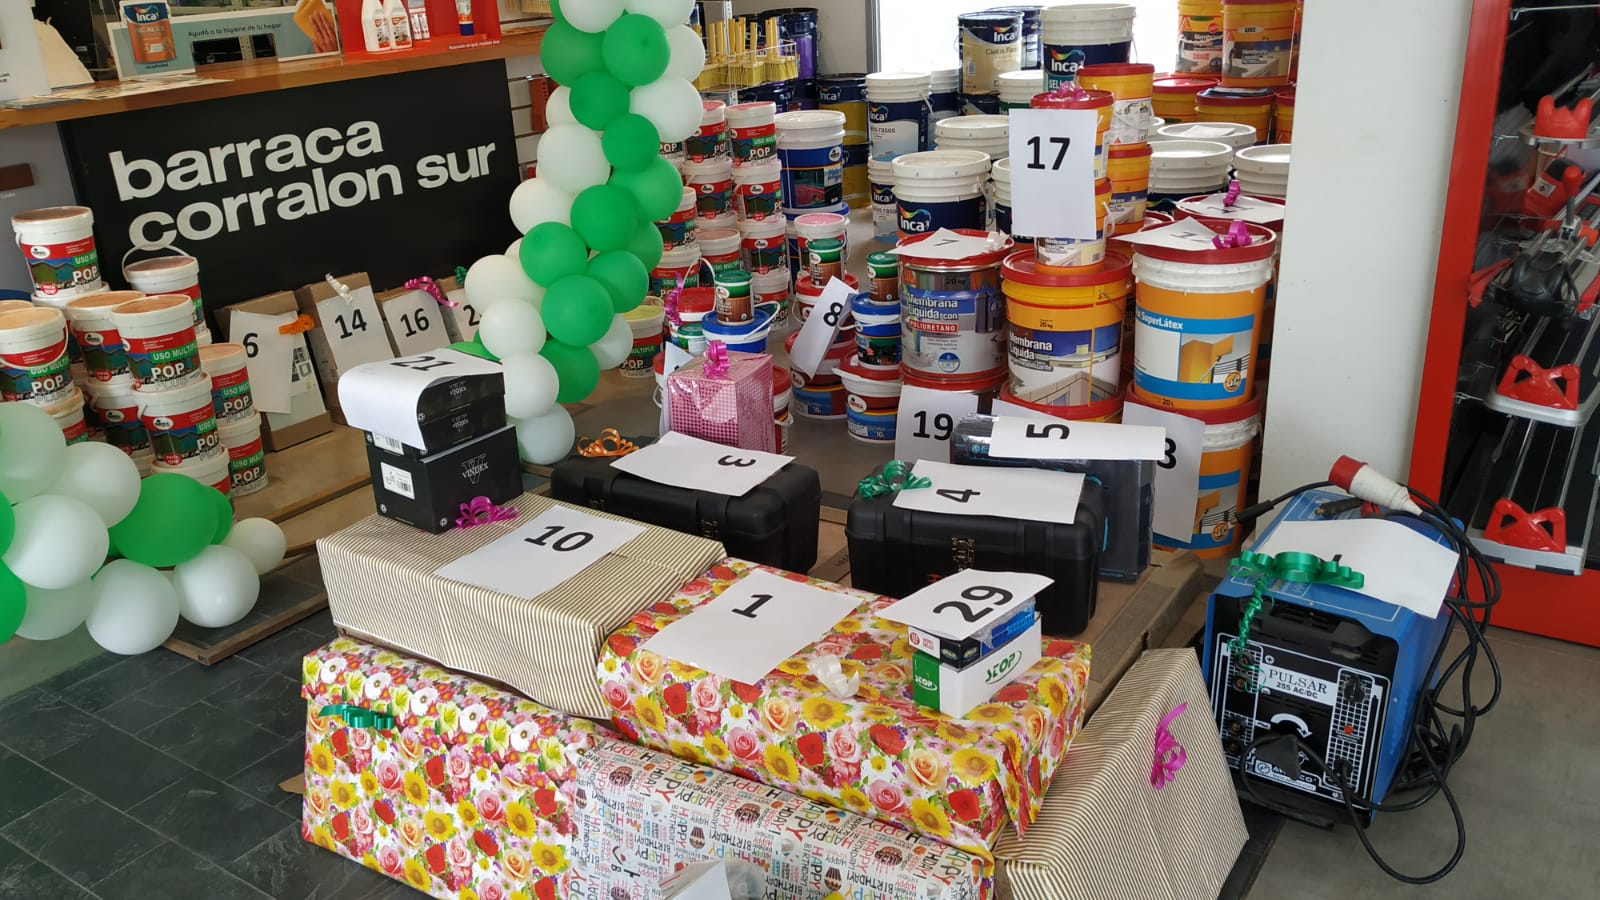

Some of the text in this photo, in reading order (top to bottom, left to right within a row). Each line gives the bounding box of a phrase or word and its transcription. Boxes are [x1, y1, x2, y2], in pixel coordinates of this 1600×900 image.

[136, 12, 157, 22] Inca
[993, 32, 1016, 42] Inca
[1051, 59, 1078, 73] Inca
[108, 119, 384, 201] barraca
[750, 147, 770, 158] POP
[1027, 136, 1071, 171] 17
[128, 141, 497, 250] corralon sur
[900, 218, 925, 232] Inca
[73, 266, 97, 284] POP
[908, 292, 958, 309] Membrana
[334, 308, 367, 339] 14
[400, 308, 430, 338] 16
[822, 302, 844, 327] 8
[943, 312, 958, 320] con
[1141, 311, 1184, 330] SuperLátex
[243, 333, 259, 358] 6
[1009, 331, 1053, 351] Membrana
[153, 351, 170, 361] USO
[151, 362, 185, 381] POP
[31, 374, 64, 395] POP
[224, 395, 250, 413] POP
[912, 410, 954, 442] 19
[1025, 423, 1070, 440] 5
[197, 431, 219, 450] POP
[233, 458, 247, 468] USO
[461, 461, 489, 479] VINDEX
[717, 453, 757, 468] 3
[233, 466, 260, 484] POP
[936, 487, 981, 504] 4
[523, 524, 595, 552] 10
[730, 593, 775, 619] 1
[932, 585, 1014, 623] 29
[1268, 668, 1328, 695] PULSAR
[1276, 681, 1318, 699] 255 AC/DC
[604, 742, 656, 761] HAPPY
[675, 789, 716, 809] HAPPY
[726, 779, 782, 799] HAPPY
[719, 797, 739, 832] HAPPY
[676, 807, 690, 848] HAPPY
[862, 820, 922, 843] HAPPY
[635, 834, 671, 853] BIRTHDAY!
[709, 829, 752, 850] BIRTHDAY!
[808, 828, 853, 849] HAPPY
[635, 845, 670, 867] HAPPY
[857, 840, 879, 874] HAPPY
[809, 845, 825, 890] HAPPY
[847, 870, 894, 895] BIRTHDAY!
